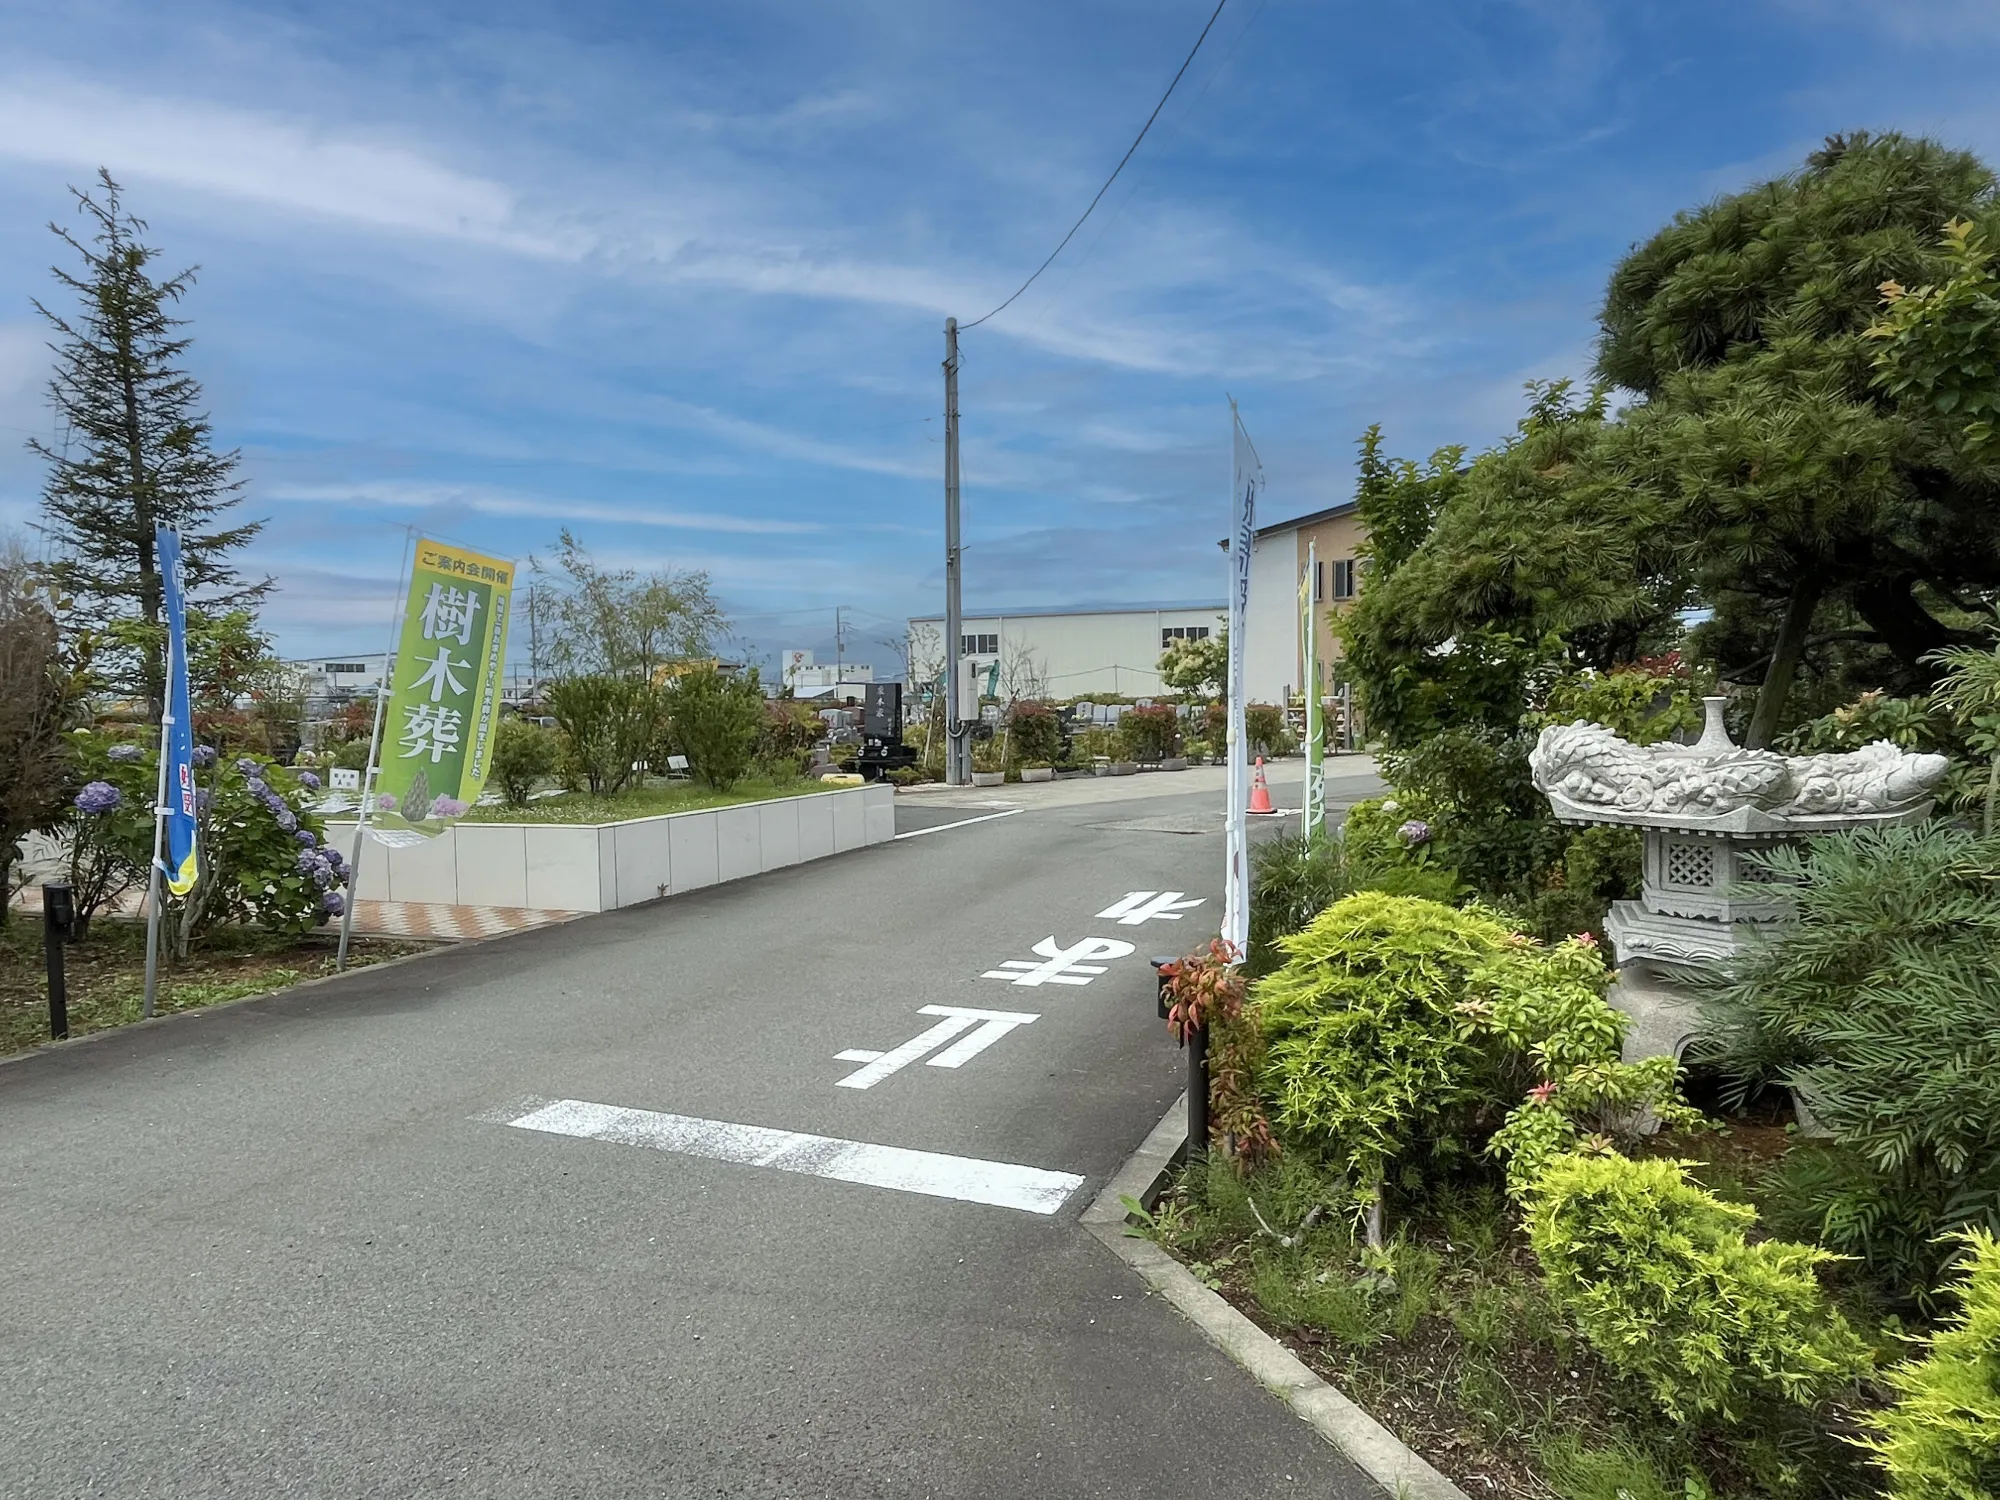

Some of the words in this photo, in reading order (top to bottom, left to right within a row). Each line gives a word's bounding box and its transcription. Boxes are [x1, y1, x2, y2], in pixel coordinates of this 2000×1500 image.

[422, 550, 509, 585] ご案内会開催
[398, 582, 482, 764] 樹木葬
[832, 890, 1208, 1090] 止まれ
